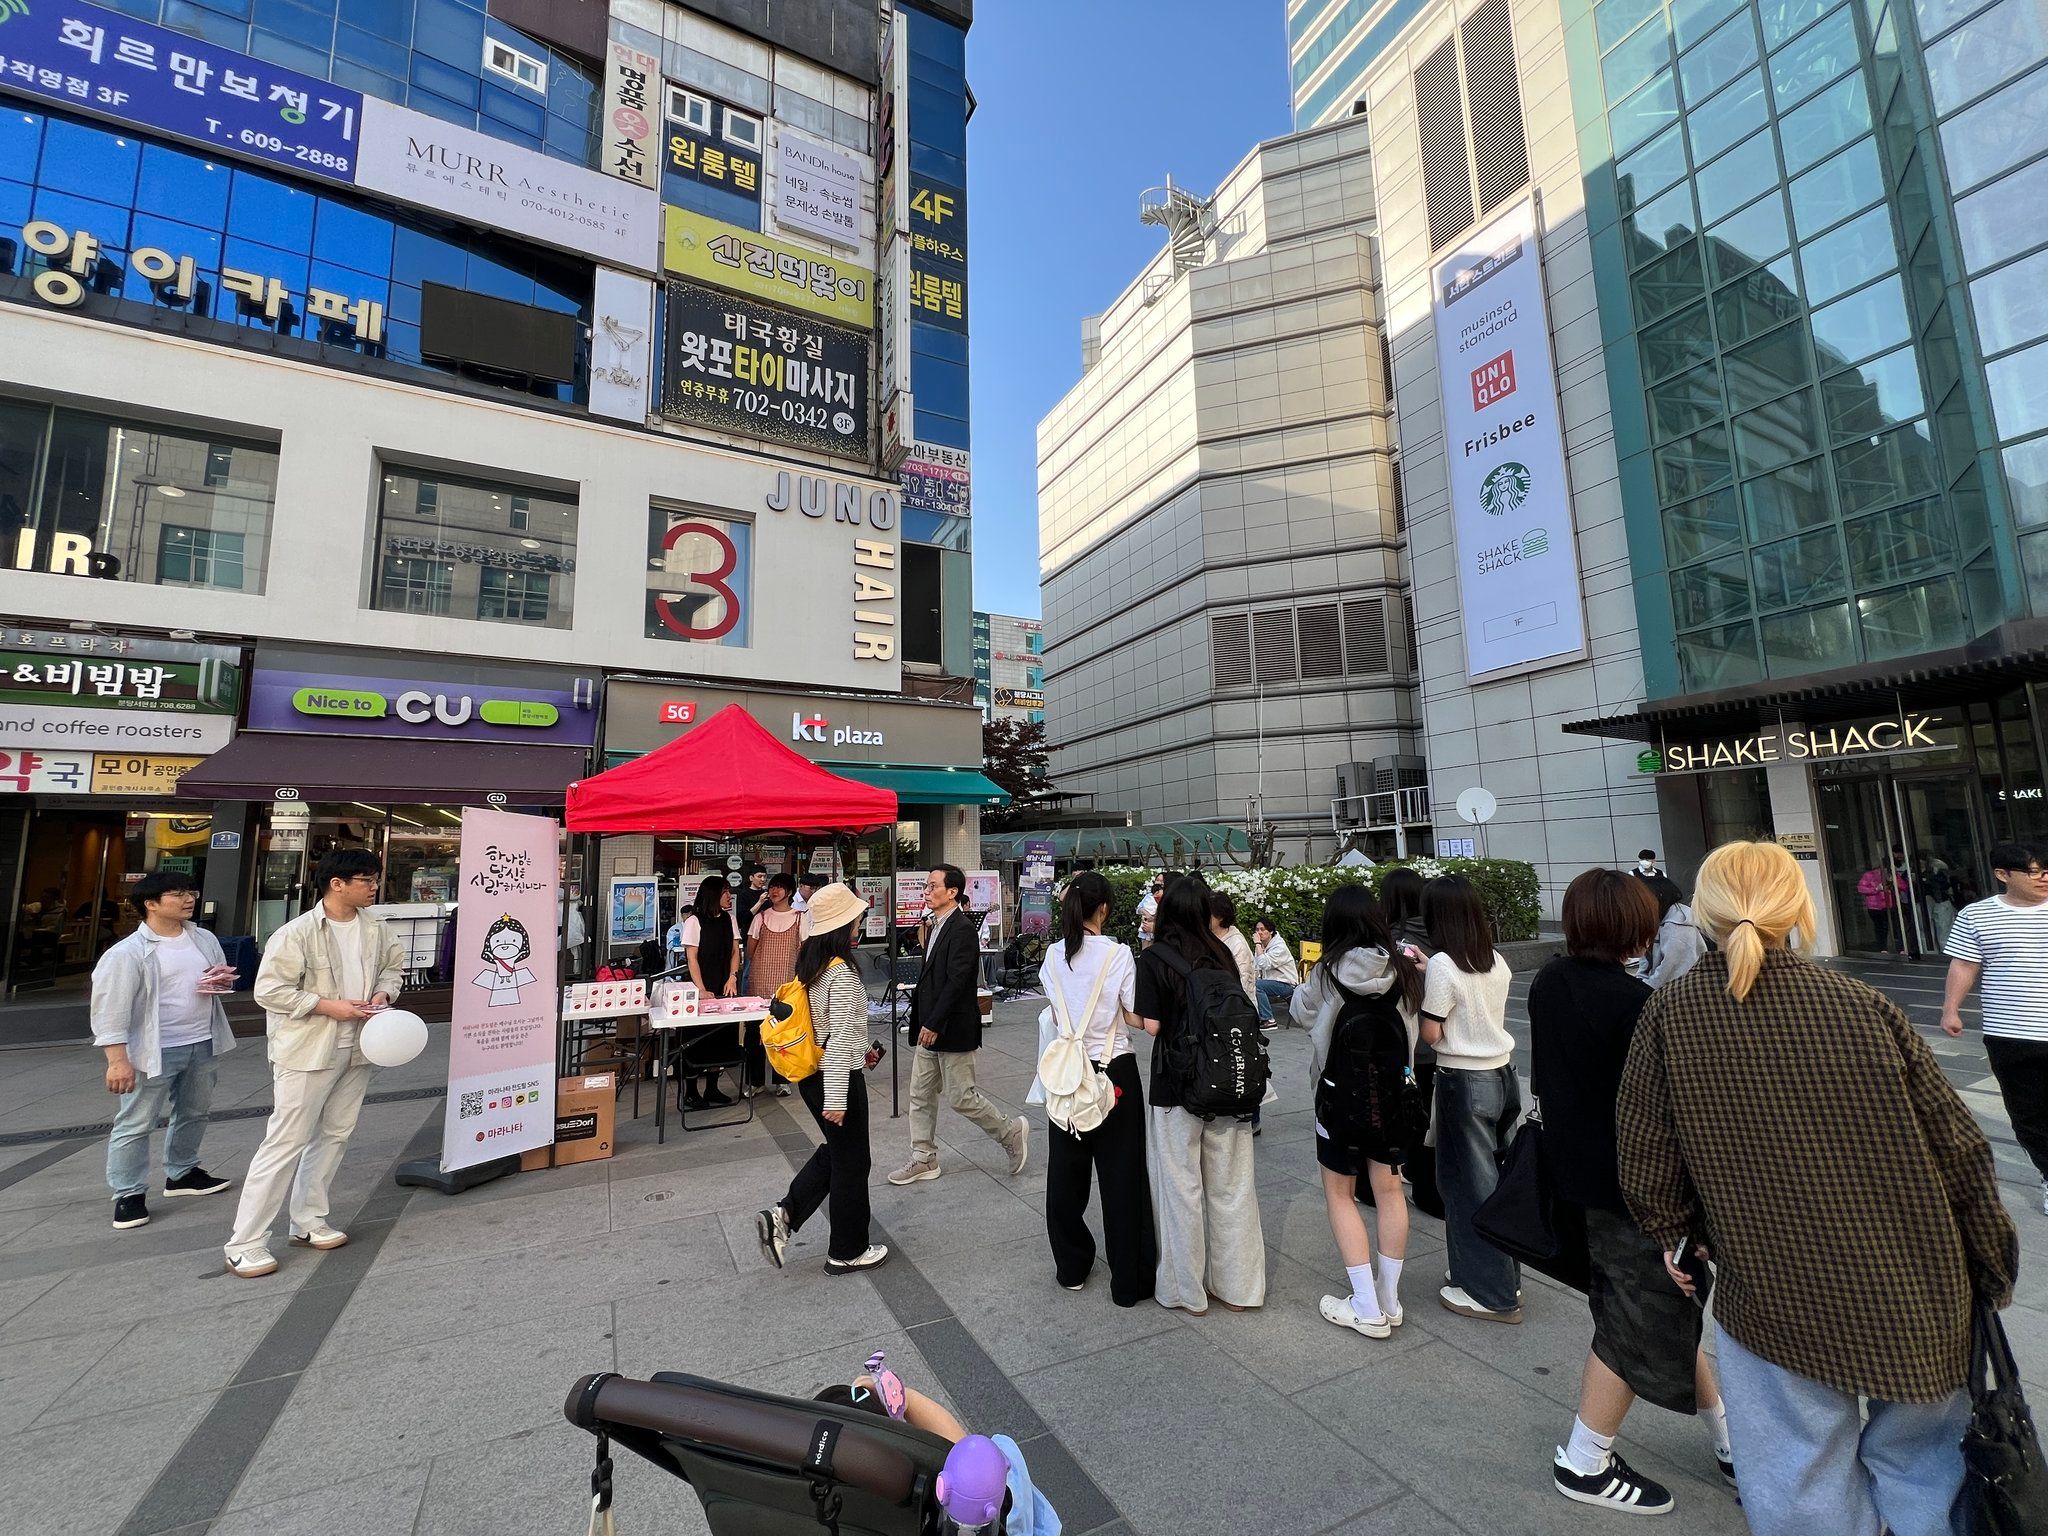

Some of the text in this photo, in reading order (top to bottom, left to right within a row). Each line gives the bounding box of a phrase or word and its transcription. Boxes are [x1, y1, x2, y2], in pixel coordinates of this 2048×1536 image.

[97, 87, 130, 107] 3F
[240, 129, 348, 172] 609-2888
[668, 135, 757, 192] 원룸텔
[406, 136, 631, 221] MURR Aesthetic
[785, 175, 853, 209] 네일 속눈썹
[521, 199, 606, 231] 070-4012-0585
[784, 195, 854, 229] 문제성 손발톱
[910, 188, 955, 225] 4F
[706, 234, 866, 302] 신전떡볶이
[1459, 308, 1518, 353] standard
[1461, 299, 1512, 338] musinsa
[723, 311, 824, 360] 태국황실
[680, 331, 856, 409] 왓포타이마사지
[1475, 358, 1506, 388] UNI
[680, 378, 853, 432] 연중무휴 702-0342 3F
[1477, 374, 1511, 405] QLO
[1463, 412, 1536, 458] Frisbee
[907, 462, 949, 478] 703-1717
[908, 444, 967, 469] 아부동산
[767, 472, 895, 530] JUNO
[910, 497, 951, 511] 781-1304
[1477, 538, 1519, 564] SHAKE
[1478, 551, 1522, 576] SHACK
[655, 522, 741, 640] 3
[854, 538, 895, 661] HAIR
[1514, 617, 1524, 627] 1F
[0, 661, 177, 699] &비빔밥
[160, 702, 196, 710] 708.6288
[307, 694, 372, 711] Nice to
[396, 690, 472, 726] CU
[667, 705, 689, 720] 5G
[42, 720, 110, 735] coffee
[116, 724, 202, 739] roasters
[792, 713, 883, 746] kt plaza
[1668, 715, 1936, 771] SHAKE SHACK
[97, 759, 193, 776] 모아 공인중
[485, 845, 532, 866] 하나님은
[489, 863, 526, 881] 당신을
[470, 871, 547, 896] 사랑하십니다
[1230, 1027, 1246, 1096] COVERNAT
[488, 1087, 511, 1095] 마라나타
[527, 1080, 540, 1089] SNS
[487, 1122, 523, 1138] 마라나타
